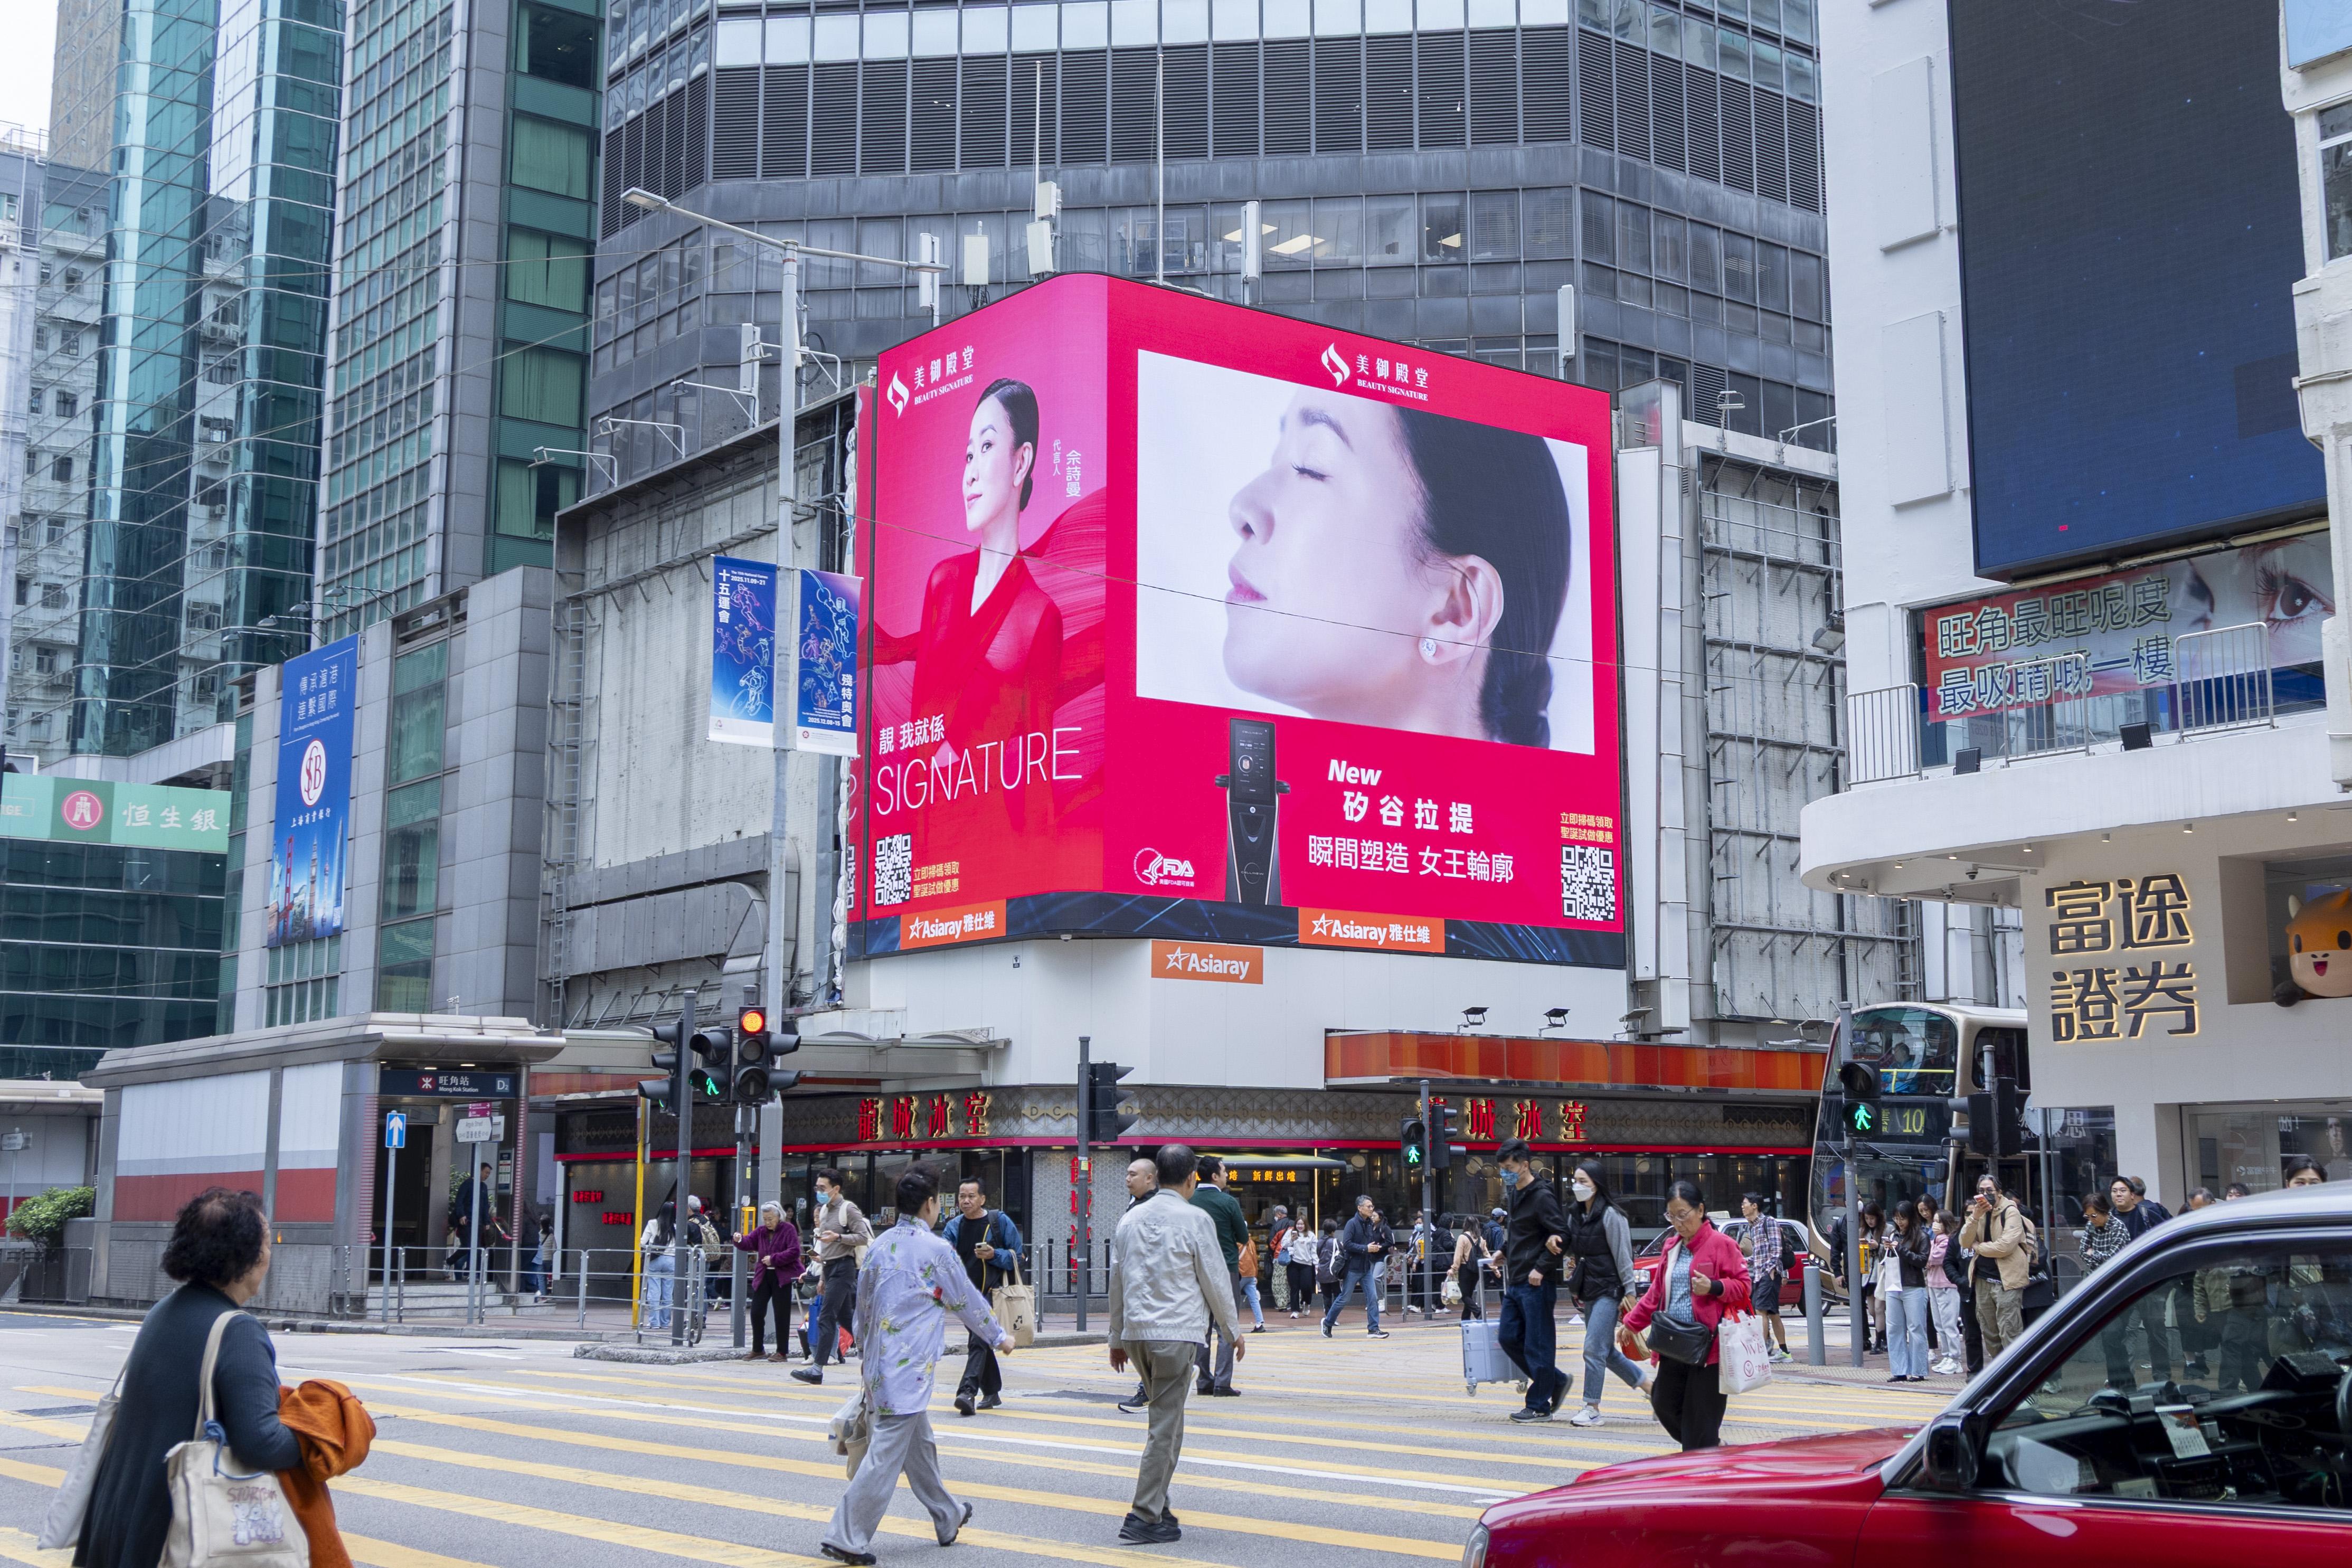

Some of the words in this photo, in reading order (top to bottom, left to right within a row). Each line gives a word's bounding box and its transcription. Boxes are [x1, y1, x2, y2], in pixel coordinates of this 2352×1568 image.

[914, 345, 974, 391] 美御殿堂
[1356, 354, 1429, 389] 美御殿堂
[914, 388, 939, 405] BEAUTY
[938, 374, 974, 396] SIGNATURE
[1357, 379, 1387, 393] BEAUTY
[1387, 385, 1428, 401] SIGNATURE
[1053, 439, 1061, 476] 代言人
[1065, 449, 1082, 497] 佘詩曼
[718, 569, 730, 624] 十五運會
[1938, 575, 2172, 659] 旺角最旺呢度
[841, 674, 853, 728] 殘特奧會
[879, 726, 894, 755] 靚
[899, 713, 945, 750] 我就係
[877, 726, 1082, 816] SIGNATURE
[1328, 759, 1382, 786] New
[122, 801, 229, 832] 恒生銀
[1343, 791, 1473, 834] 矽谷拉提
[1560, 811, 1613, 829] 立即掃碼領取
[1561, 826, 1613, 843] 聖誕試做優惠
[913, 861, 959, 882] 立即掃碼領取
[1163, 858, 1195, 877] FDA
[1308, 835, 1410, 874] 瞬間塑造
[1419, 845, 1514, 883] 女王輪廓
[913, 877, 959, 899] 聖誕試做優惠
[922, 917, 962, 940] Asiaray
[963, 910, 995, 933] 雅仕維
[2046, 873, 2193, 955] 富途
[1331, 920, 1387, 946] Asiaray
[1389, 924, 1430, 943] 雅仕維
[1187, 953, 1250, 980] Asiaray
[2051, 961, 2200, 1043] 證券
[439, 1075, 469, 1086] 旺角站
[497, 1080, 508, 1090] D2
[858, 1091, 988, 1141] 龍城冰室
[1252, 1169, 1296, 1182] 新鮮出爐
